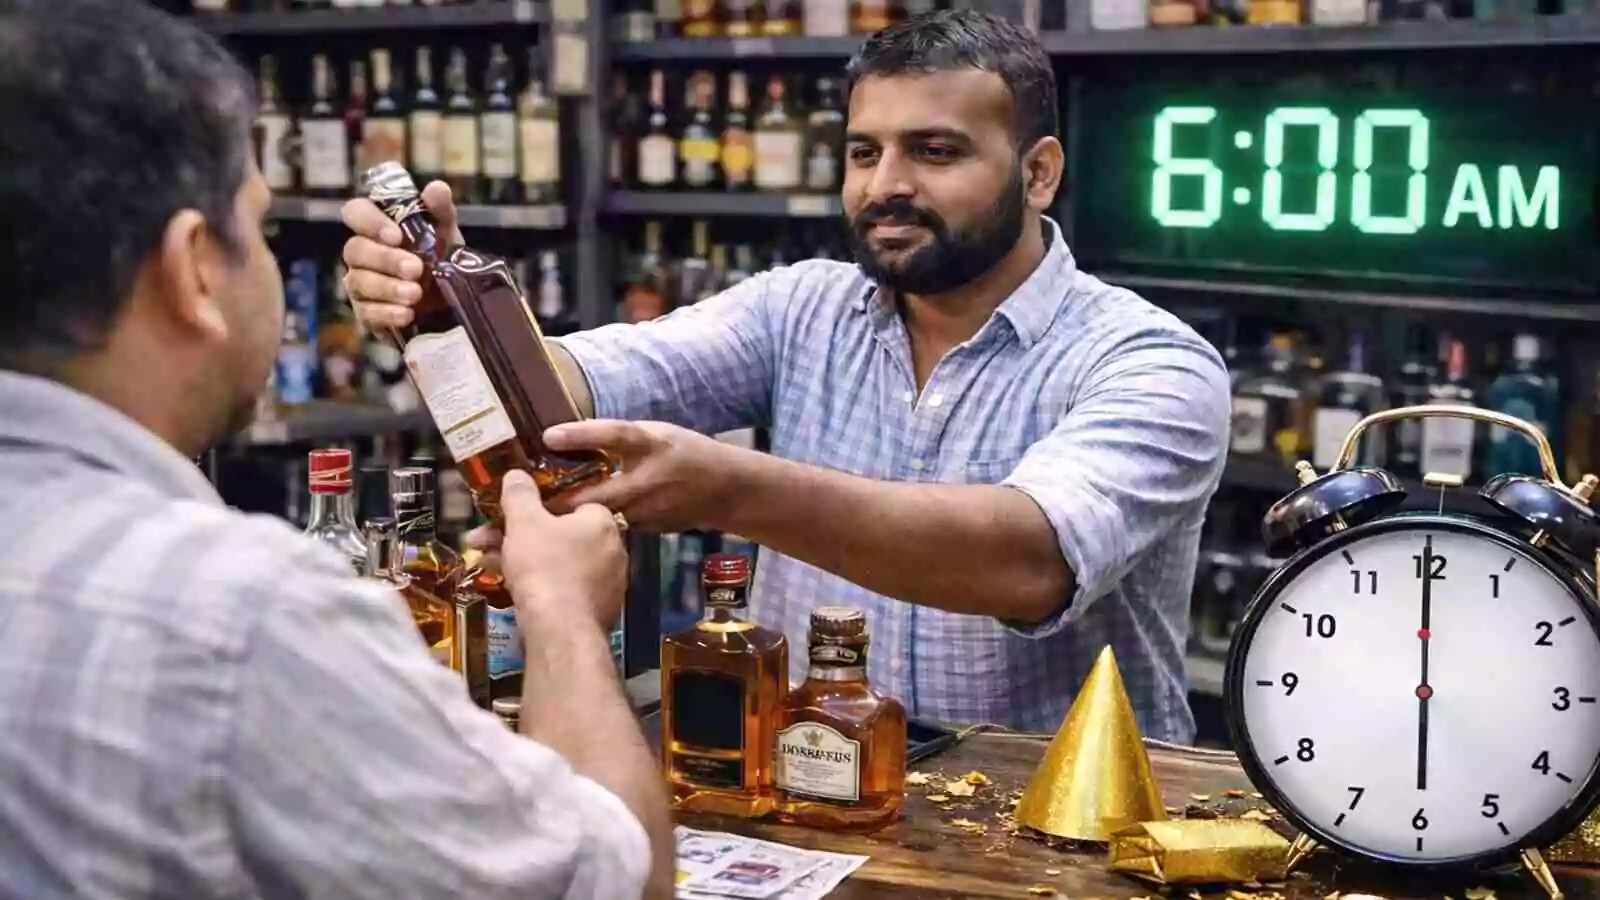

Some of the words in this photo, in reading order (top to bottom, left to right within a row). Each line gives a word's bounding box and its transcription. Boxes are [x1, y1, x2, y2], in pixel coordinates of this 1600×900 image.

[1149, 104, 1430, 235] 6:00
[1442, 162, 1561, 230] AM
[1412, 554, 1447, 580] 12
[1350, 570, 1377, 595] 11
[1489, 574, 1499, 599] 1
[1302, 613, 1336, 639] 10
[1534, 621, 1553, 647] 2
[1281, 672, 1299, 697] 9
[1551, 686, 1571, 712] 3
[1296, 737, 1315, 762] 8
[1531, 750, 1551, 776] 4
[1347, 786, 1365, 811] 7
[1481, 793, 1500, 819] 5
[1411, 807, 1429, 831] 6
